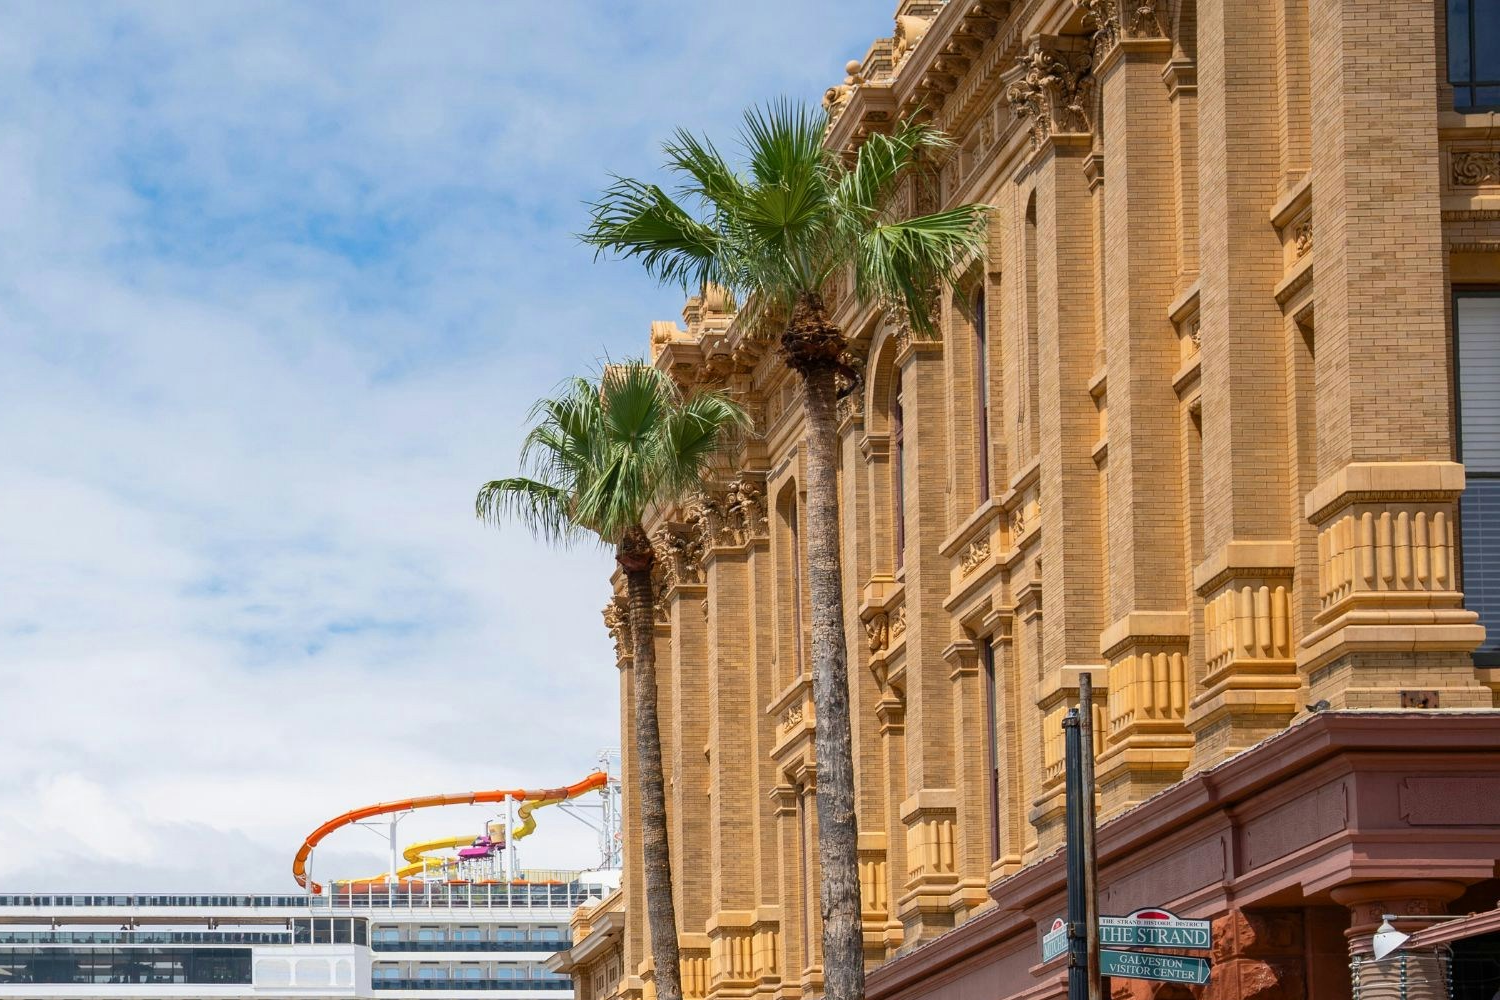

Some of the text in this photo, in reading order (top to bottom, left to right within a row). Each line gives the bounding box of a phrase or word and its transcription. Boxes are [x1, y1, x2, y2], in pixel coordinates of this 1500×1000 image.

[1101, 926, 1207, 945] THE STRAND
[1119, 954, 1183, 968] GALVESTON
[1109, 963, 1195, 980] VISITOR CENTER
